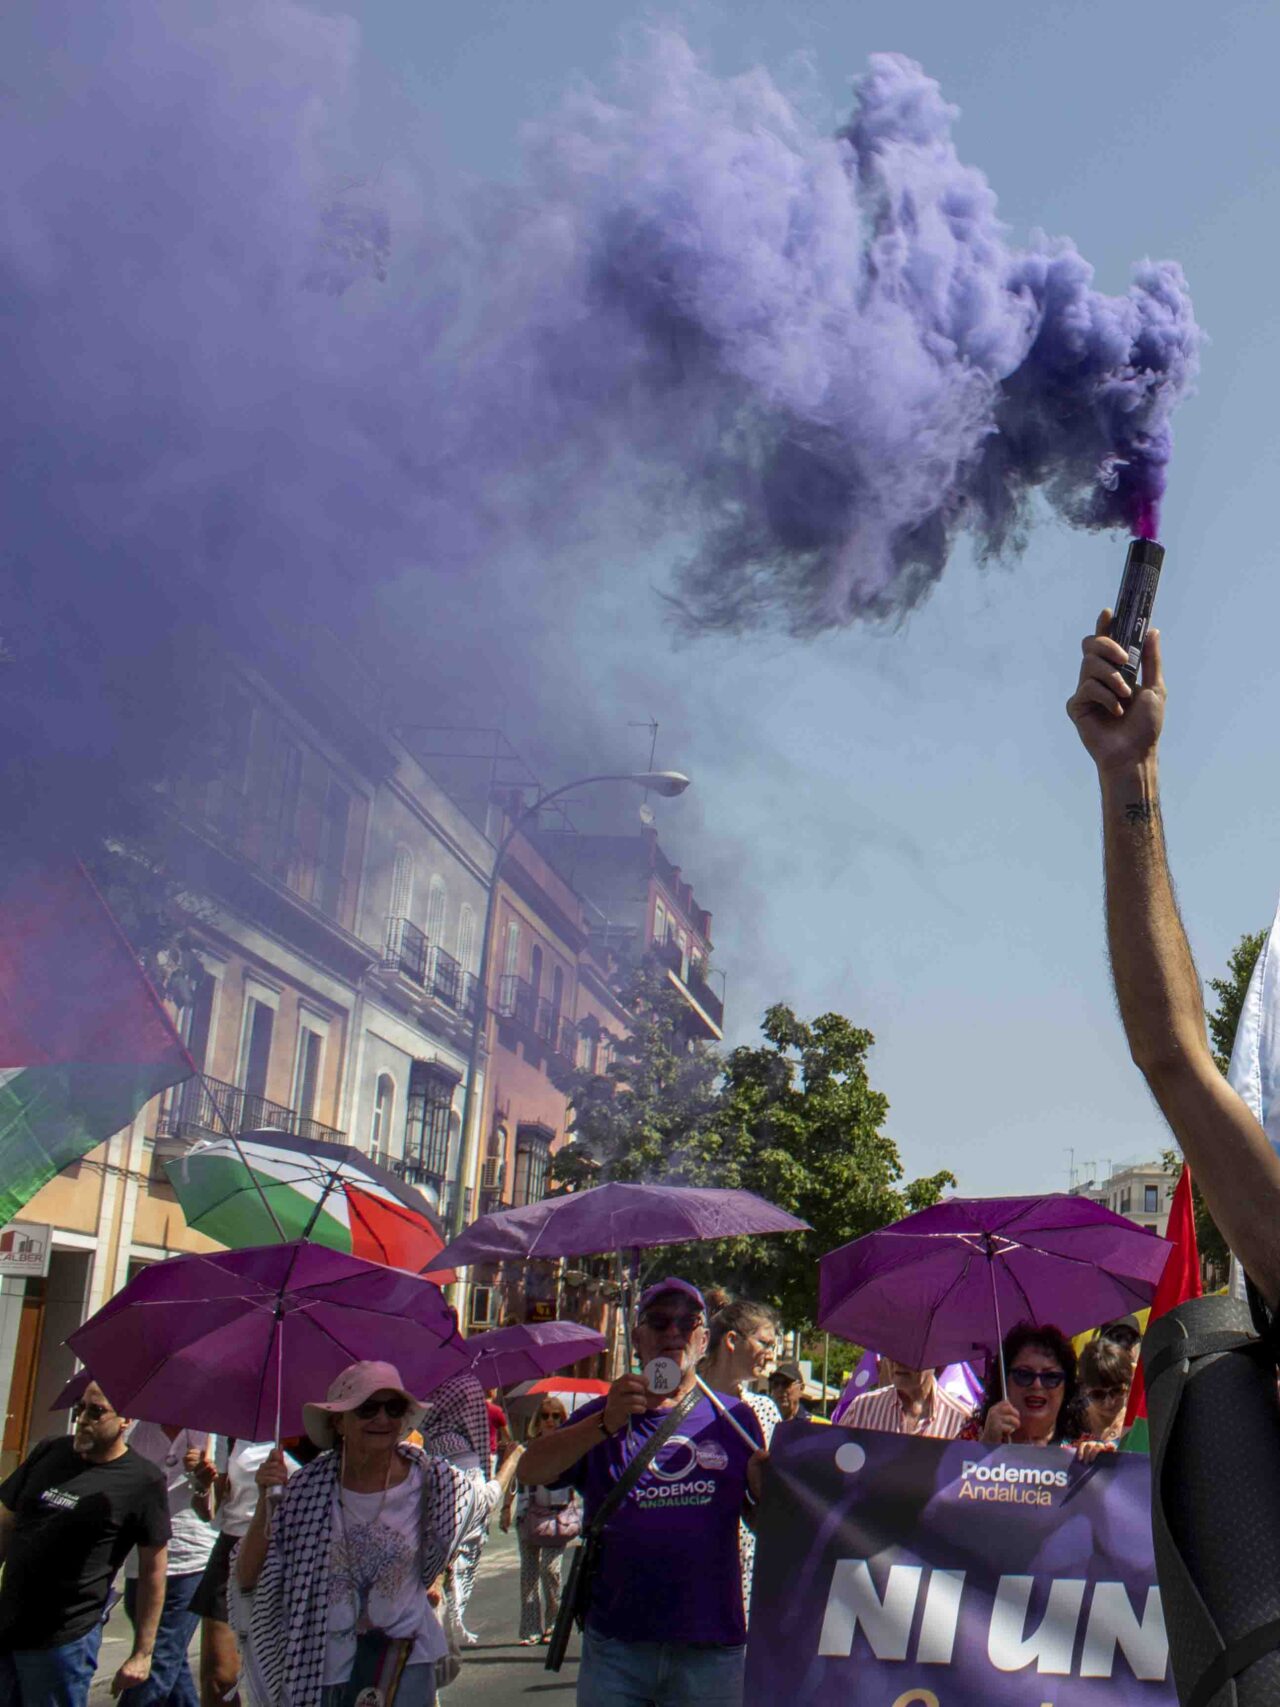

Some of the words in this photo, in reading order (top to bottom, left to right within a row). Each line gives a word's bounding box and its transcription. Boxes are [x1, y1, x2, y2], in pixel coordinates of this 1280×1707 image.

[961, 1459, 1068, 1488] Podemos
[636, 1480, 716, 1502] PODEMOS
[958, 1480, 1052, 1506] Andalucía
[818, 1558, 967, 1664] NI
[987, 1574, 1170, 1682] UN
